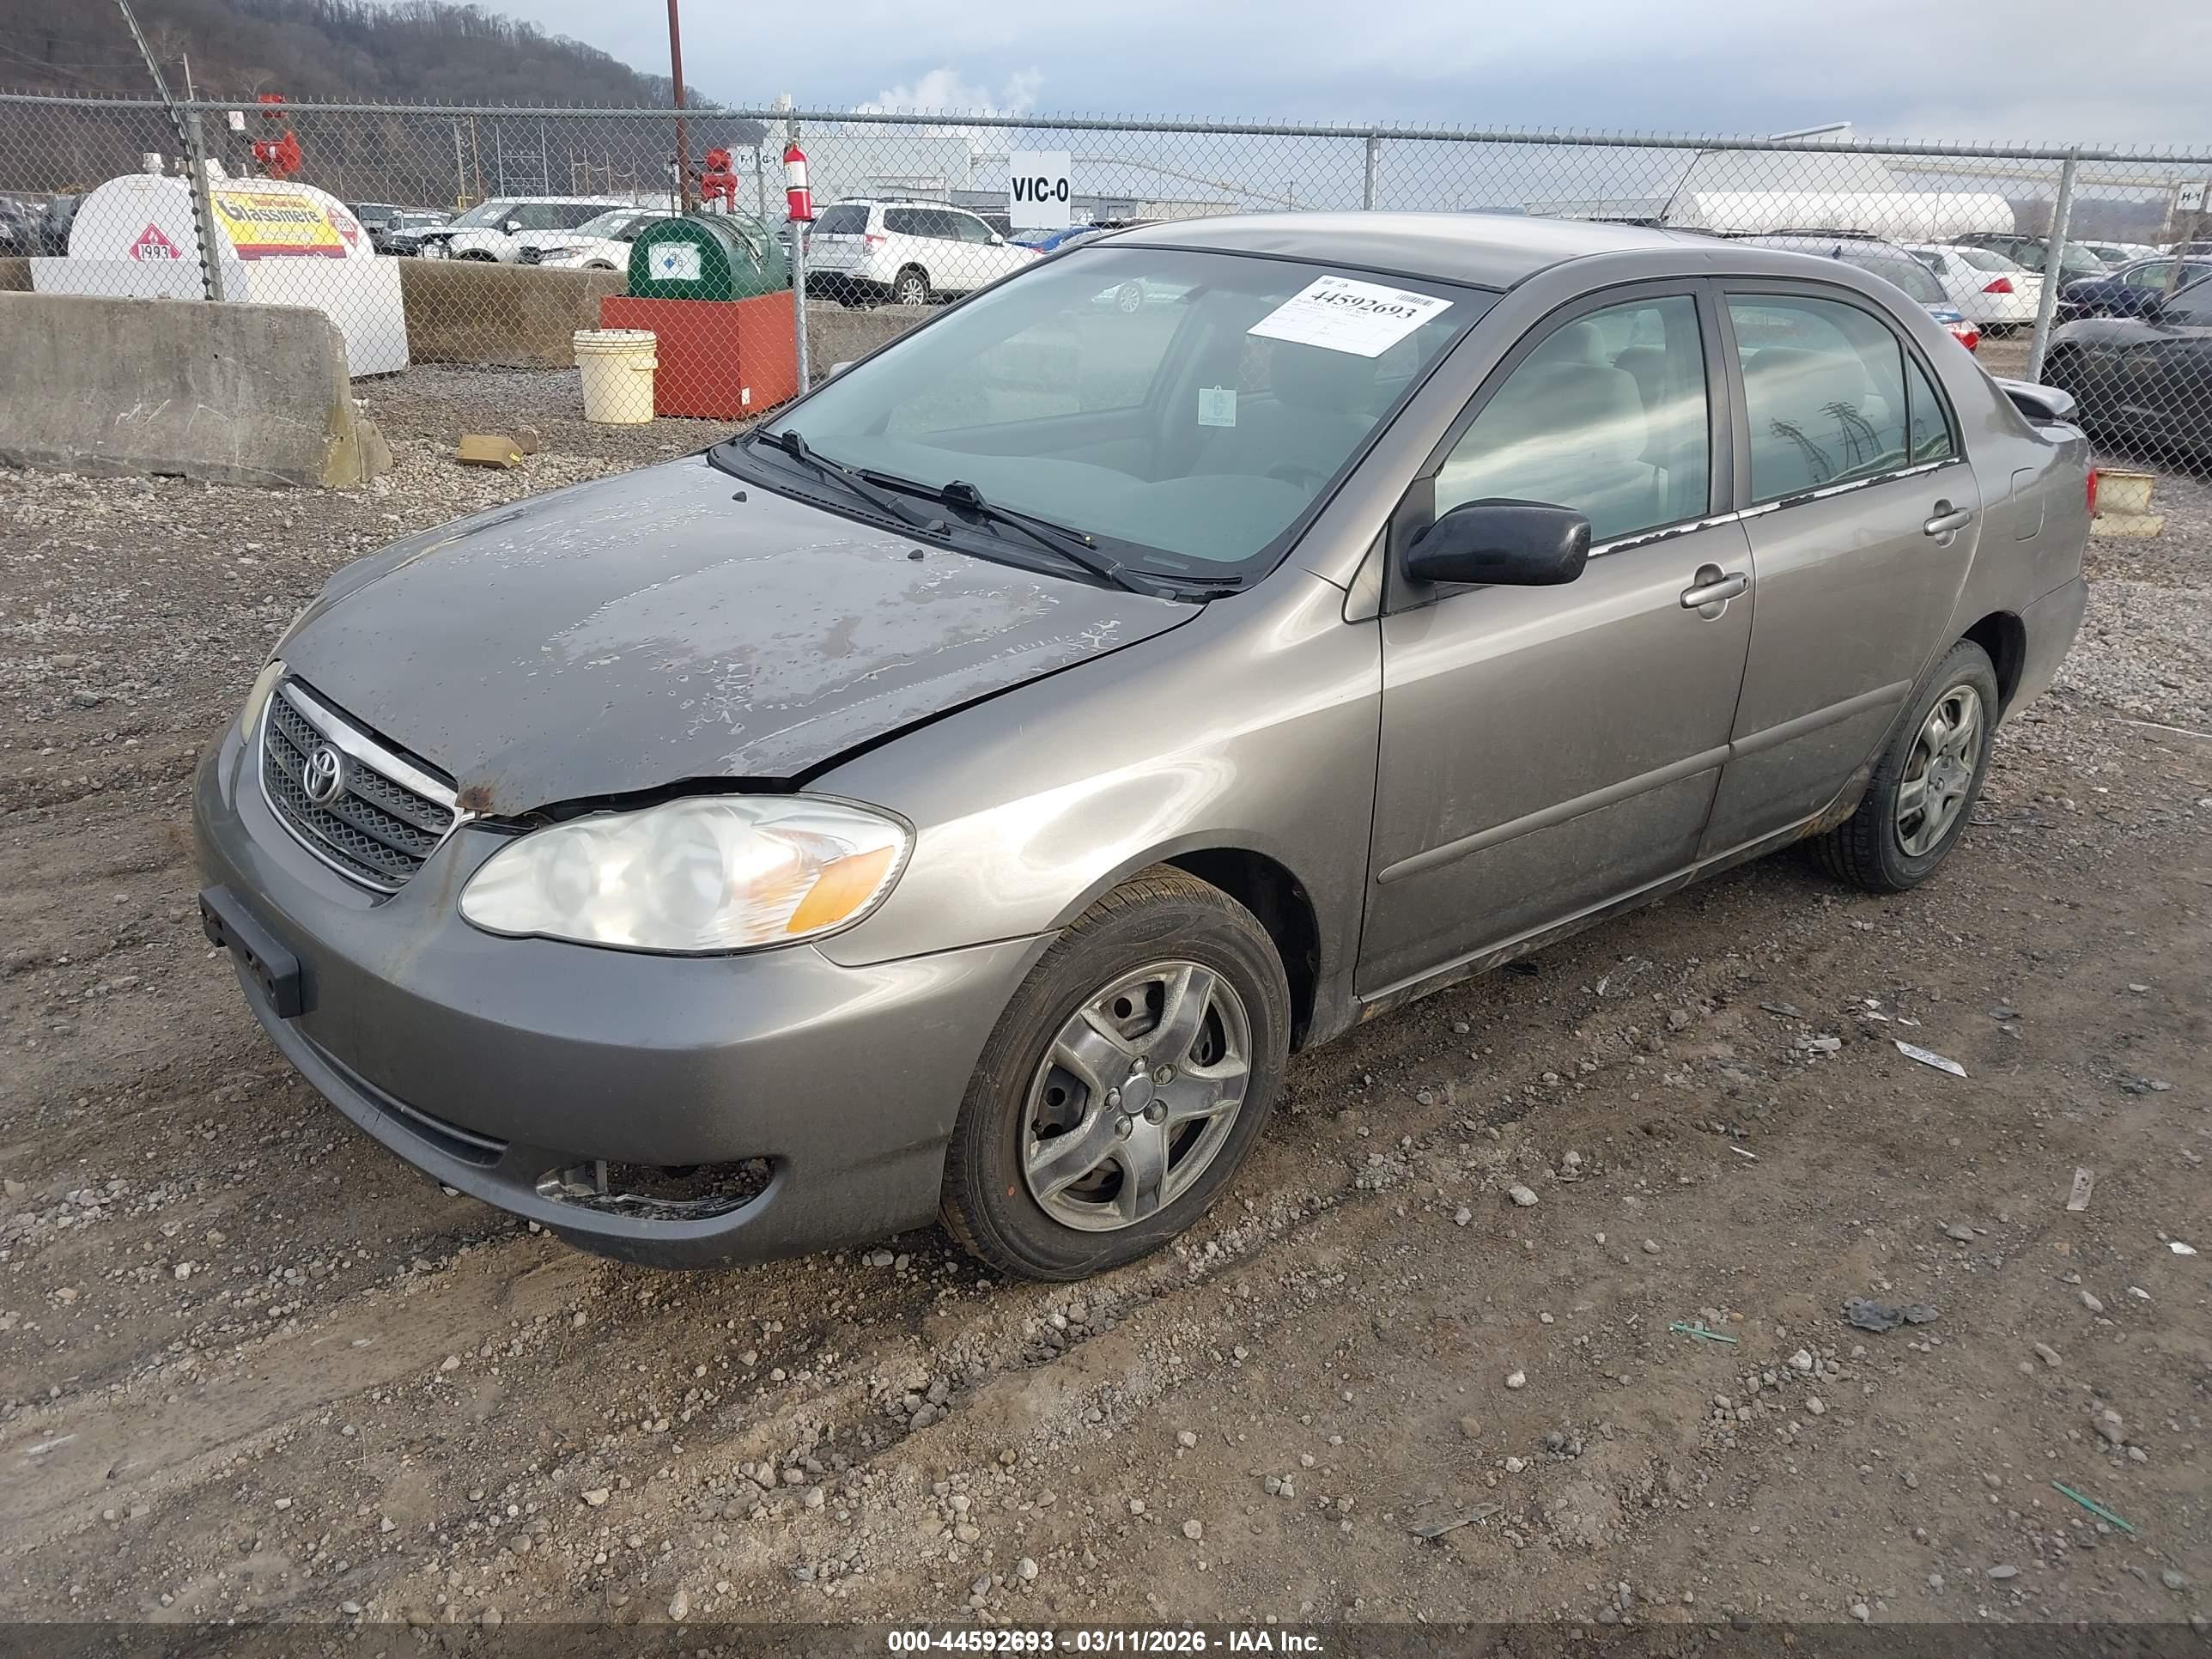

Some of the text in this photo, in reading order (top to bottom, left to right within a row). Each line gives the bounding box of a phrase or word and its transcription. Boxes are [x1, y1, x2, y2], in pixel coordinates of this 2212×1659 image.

[1011, 177, 1069, 203] VIC-0
[216, 198, 321, 224] Glassmere
[1310, 290, 1417, 319] 44592693
